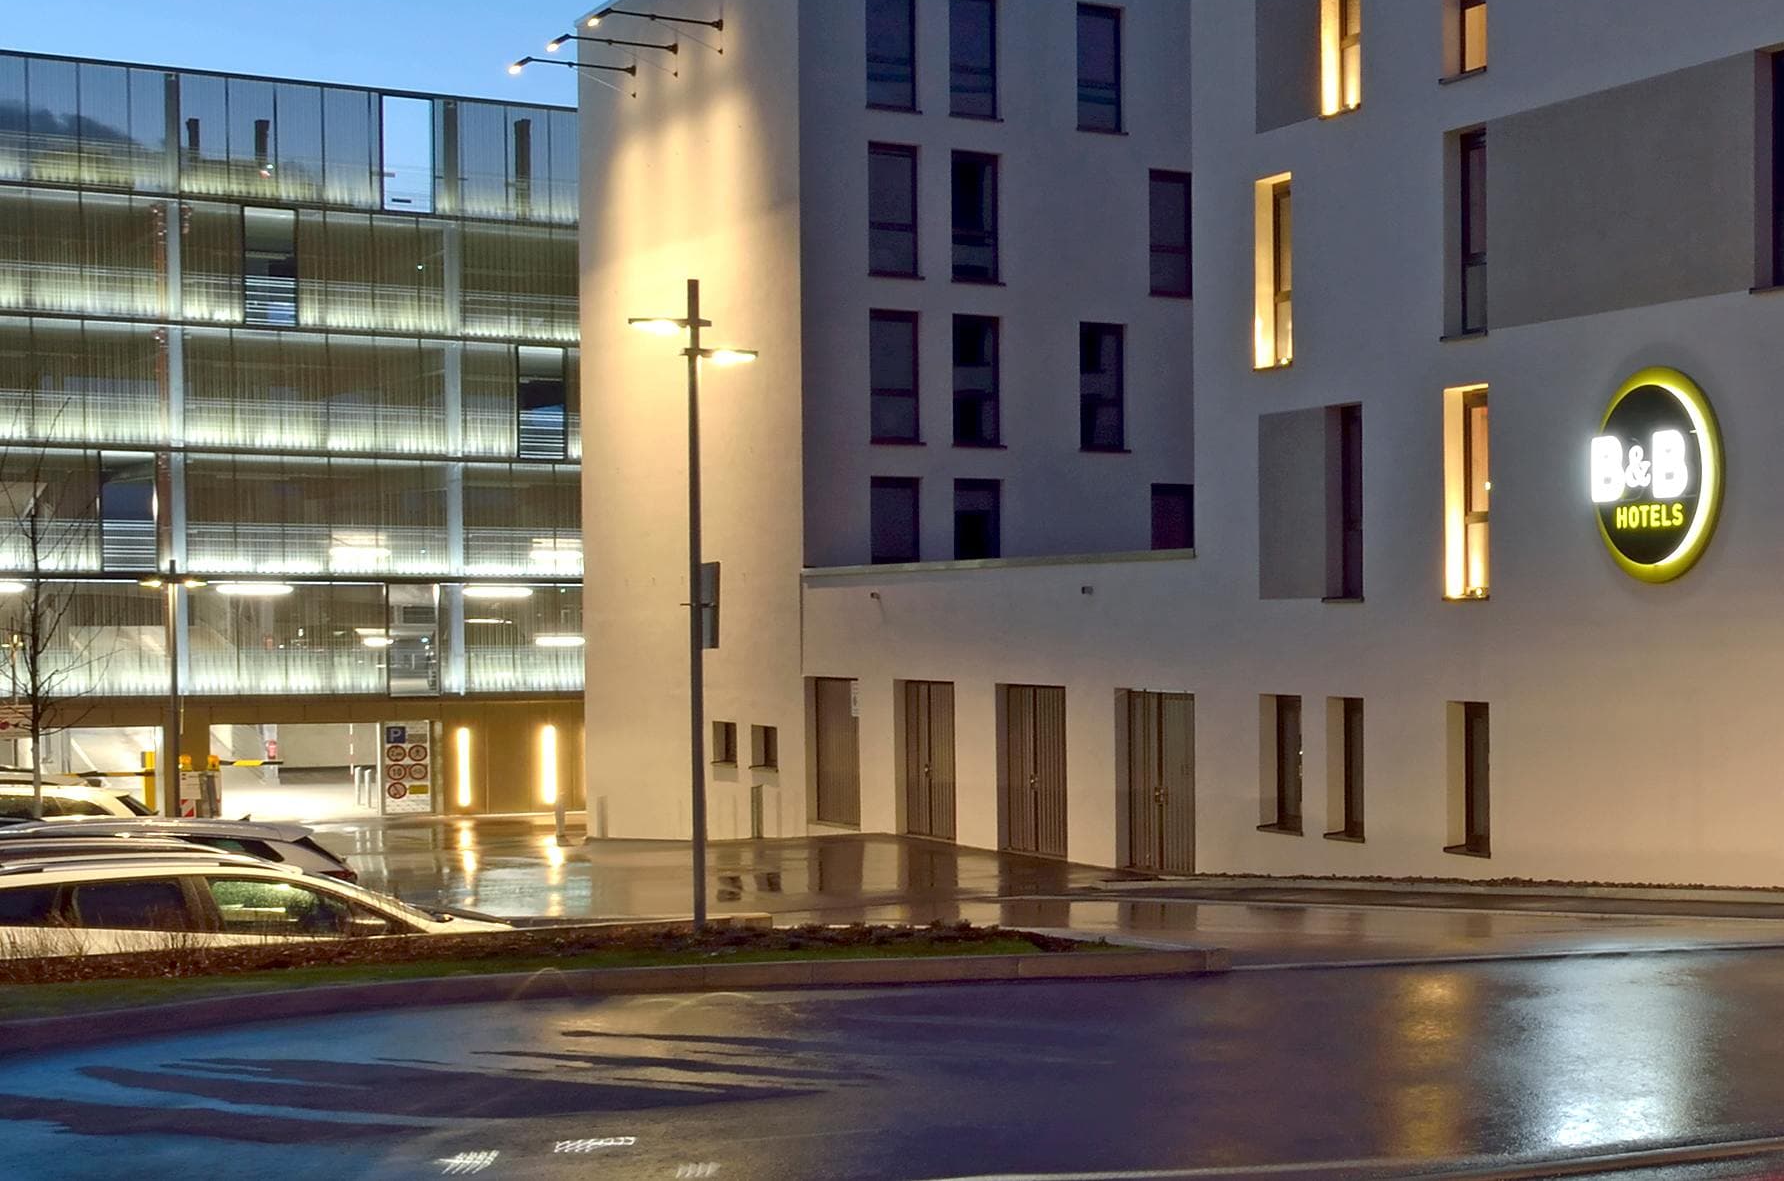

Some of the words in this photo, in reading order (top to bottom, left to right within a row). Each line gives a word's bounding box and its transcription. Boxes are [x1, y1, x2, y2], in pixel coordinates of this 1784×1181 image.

[1591, 429, 1688, 503] B&B
[1616, 503, 1684, 529] HOTELS
[390, 728, 402, 743] P
